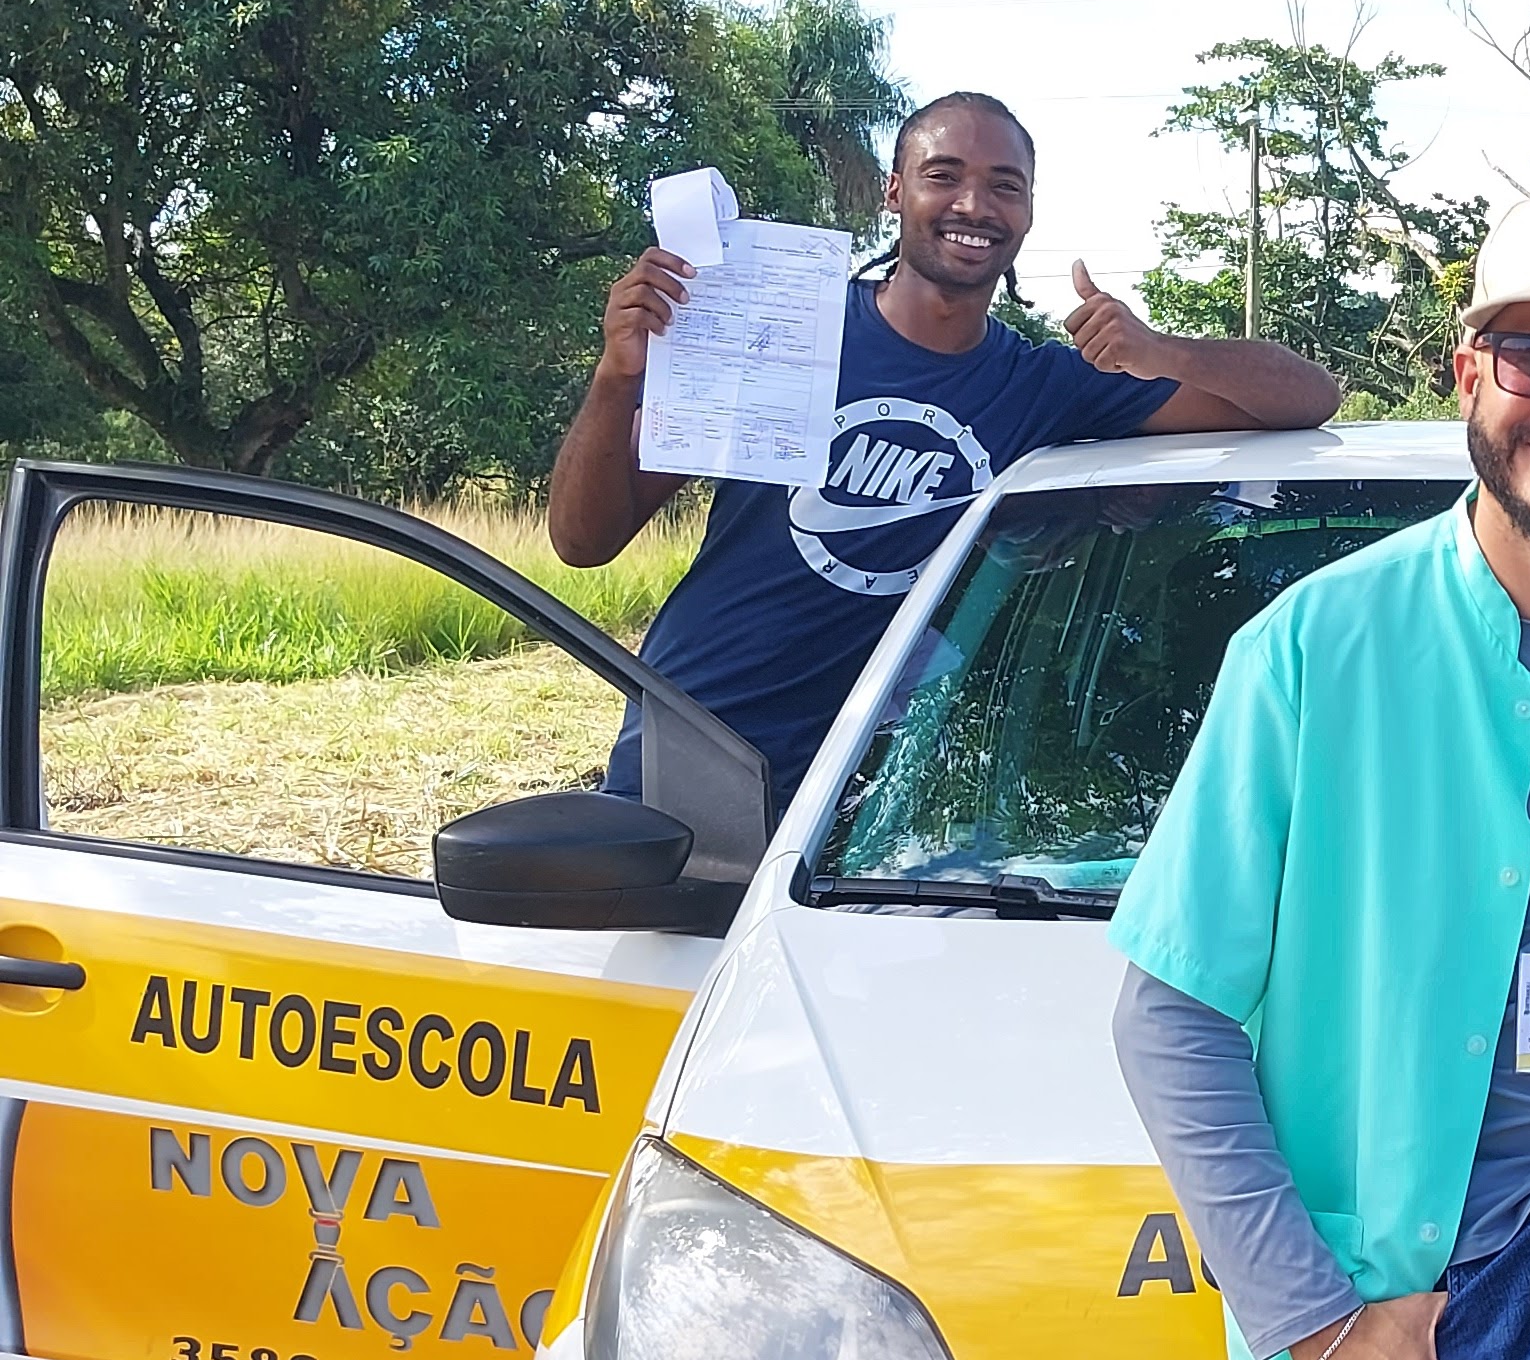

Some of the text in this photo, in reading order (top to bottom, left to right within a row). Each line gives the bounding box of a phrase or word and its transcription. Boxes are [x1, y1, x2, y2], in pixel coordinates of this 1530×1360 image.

[828, 433, 956, 505] NIKE
[131, 975, 602, 1115] AUTOESCOLA
[148, 1127, 441, 1228] NOVA
